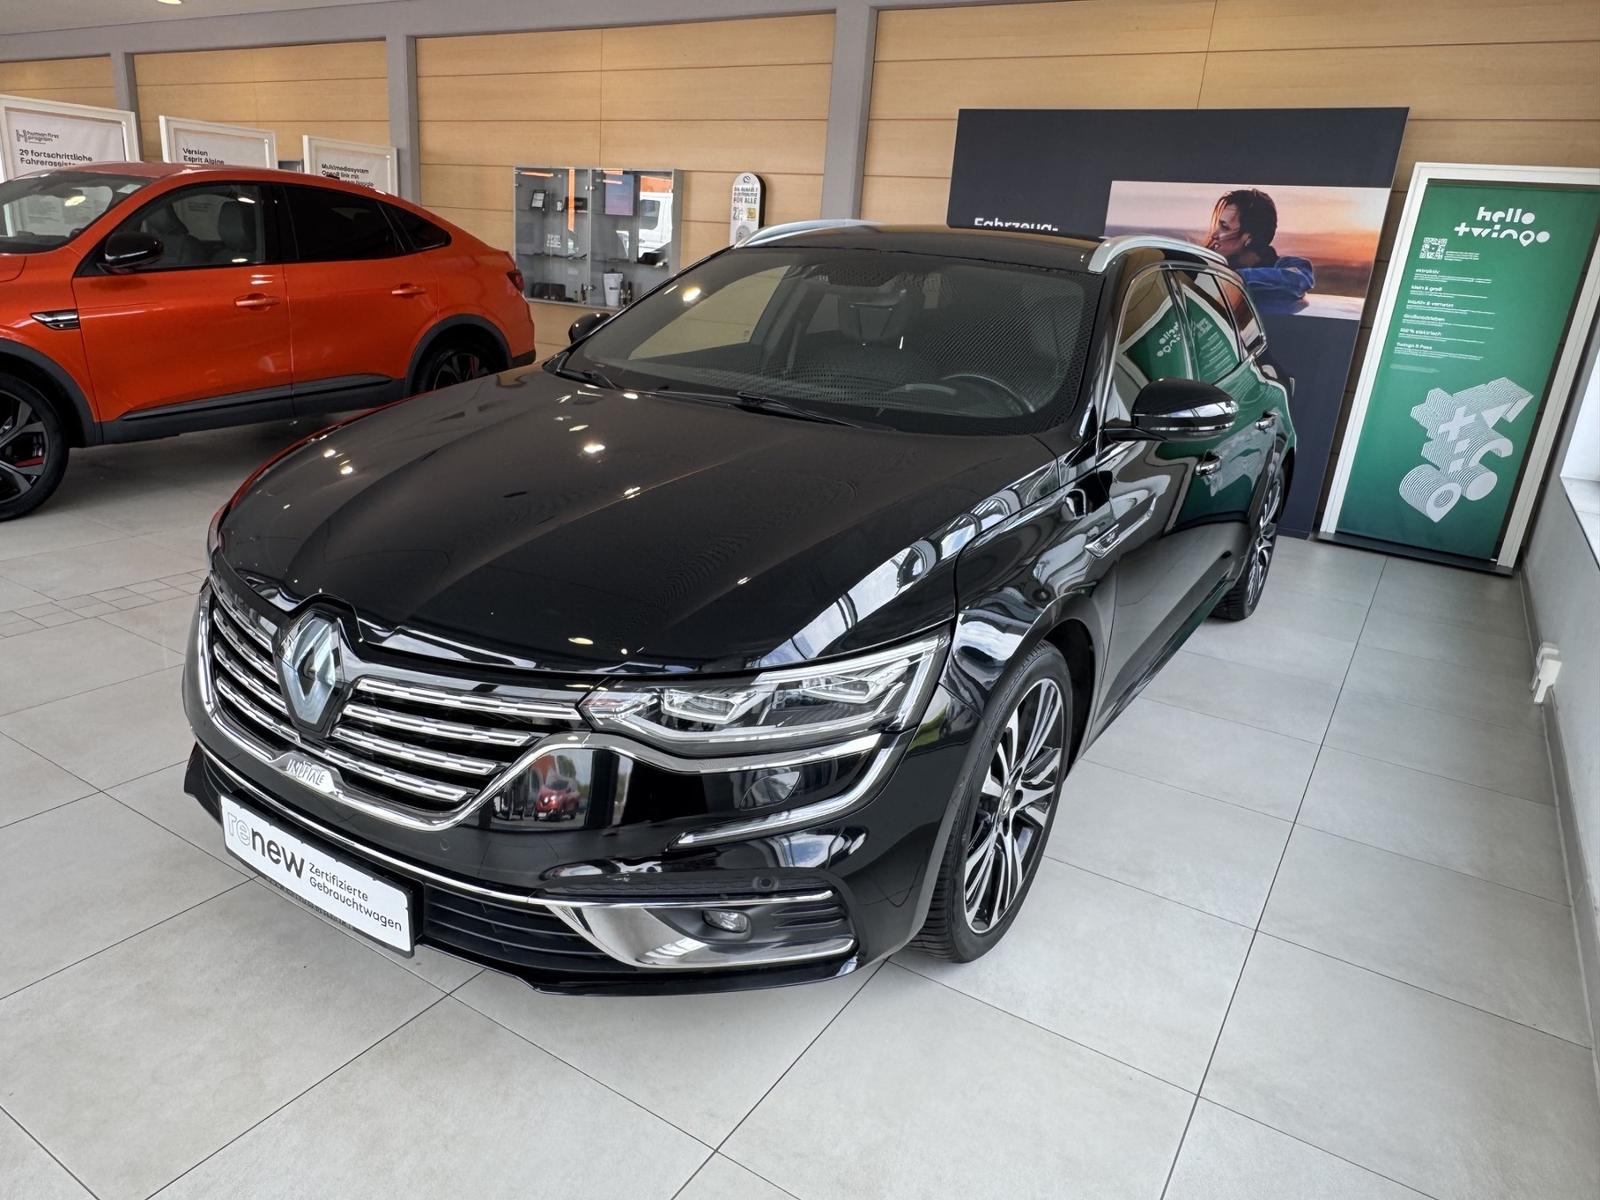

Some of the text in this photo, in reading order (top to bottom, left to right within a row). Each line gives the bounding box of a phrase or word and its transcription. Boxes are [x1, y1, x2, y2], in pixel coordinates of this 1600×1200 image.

[19, 149, 93, 162] 29 fortschrittliche
[182, 147, 209, 156] Version
[1475, 206, 1536, 225] hello
[227, 811, 306, 879] renew
[309, 861, 369, 902] Zertifizierte
[309, 876, 402, 932] Gebrauchtwagen
